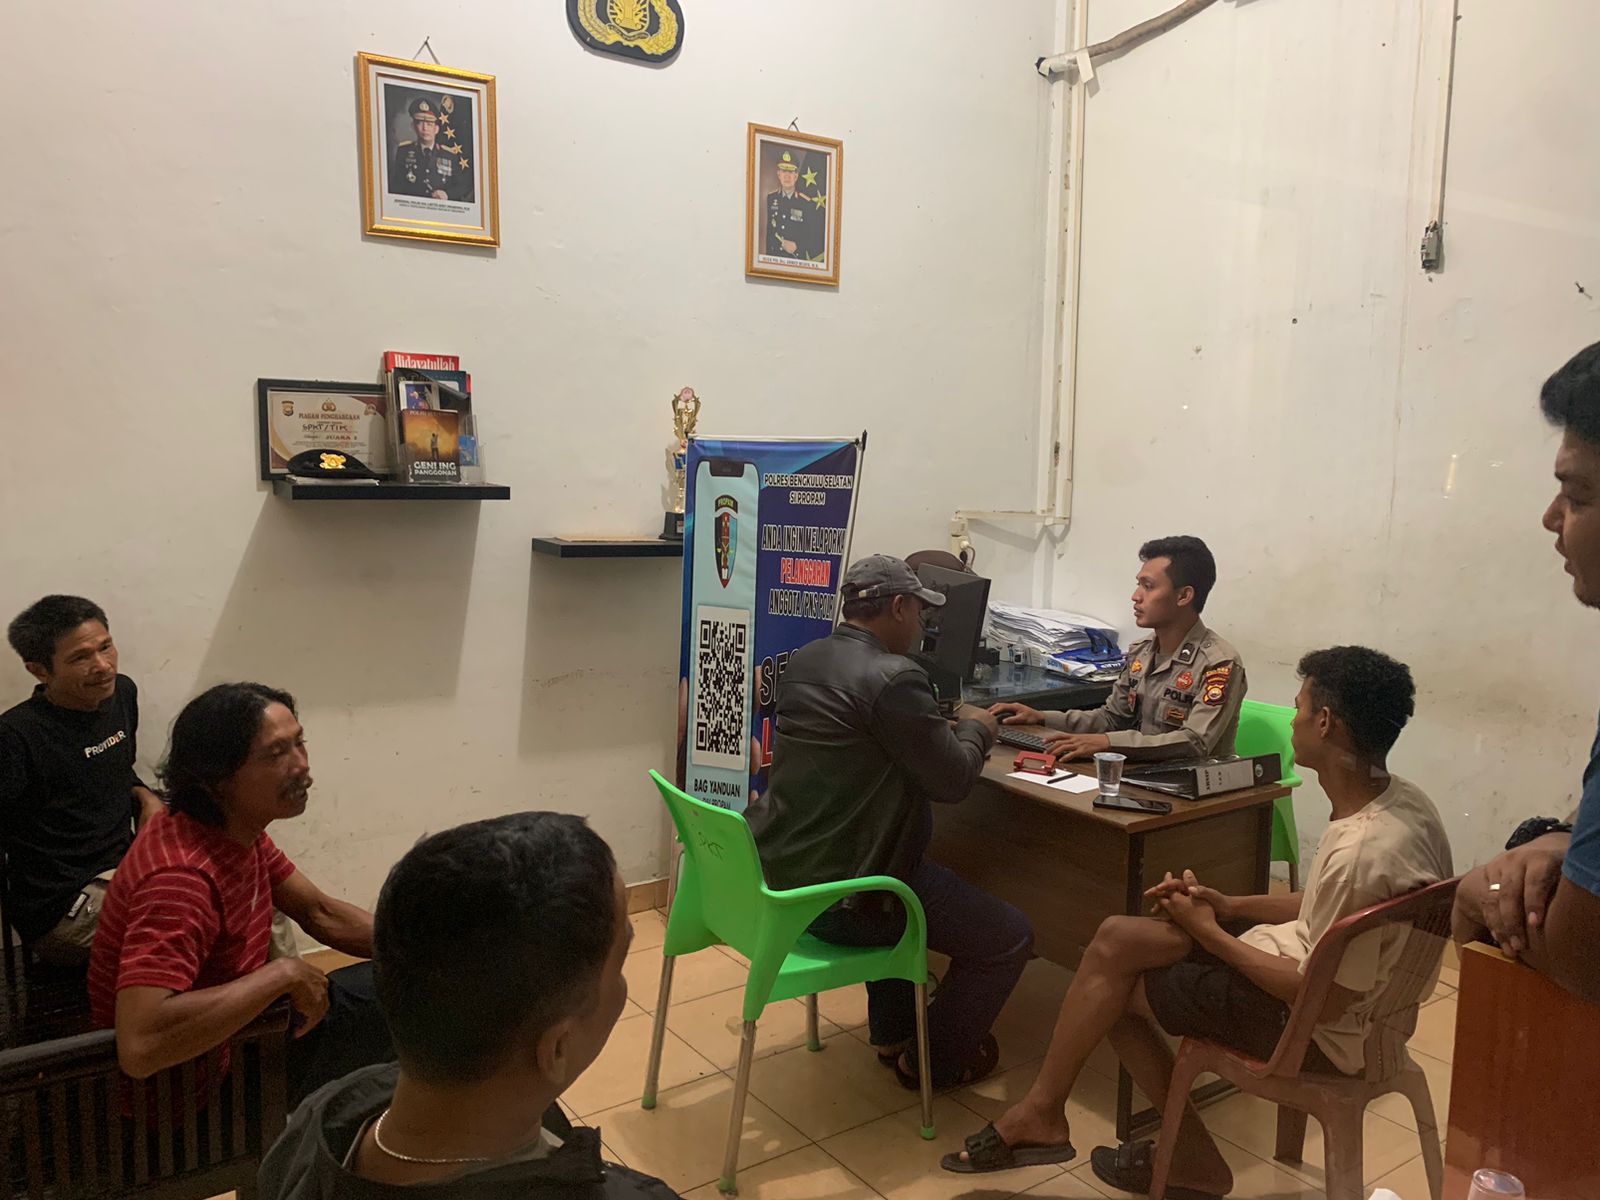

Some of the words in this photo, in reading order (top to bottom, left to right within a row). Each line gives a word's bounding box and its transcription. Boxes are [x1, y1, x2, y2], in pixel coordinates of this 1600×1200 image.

[394, 353, 456, 371] Hidayatullah
[764, 473, 789, 487] POLRES
[789, 474, 824, 488] BENGKULU
[824, 476, 853, 489] SELATAN
[797, 492, 826, 505] PROPAM
[761, 524, 782, 551] ANDA
[782, 525, 804, 553] INGIN
[804, 526, 847, 555] MELAPORKA
[780, 557, 831, 587] PELANGGARAN
[84, 730, 126, 758] PROVIDER
[693, 778, 708, 793] BAG
[709, 780, 740, 798] YANDUAN
